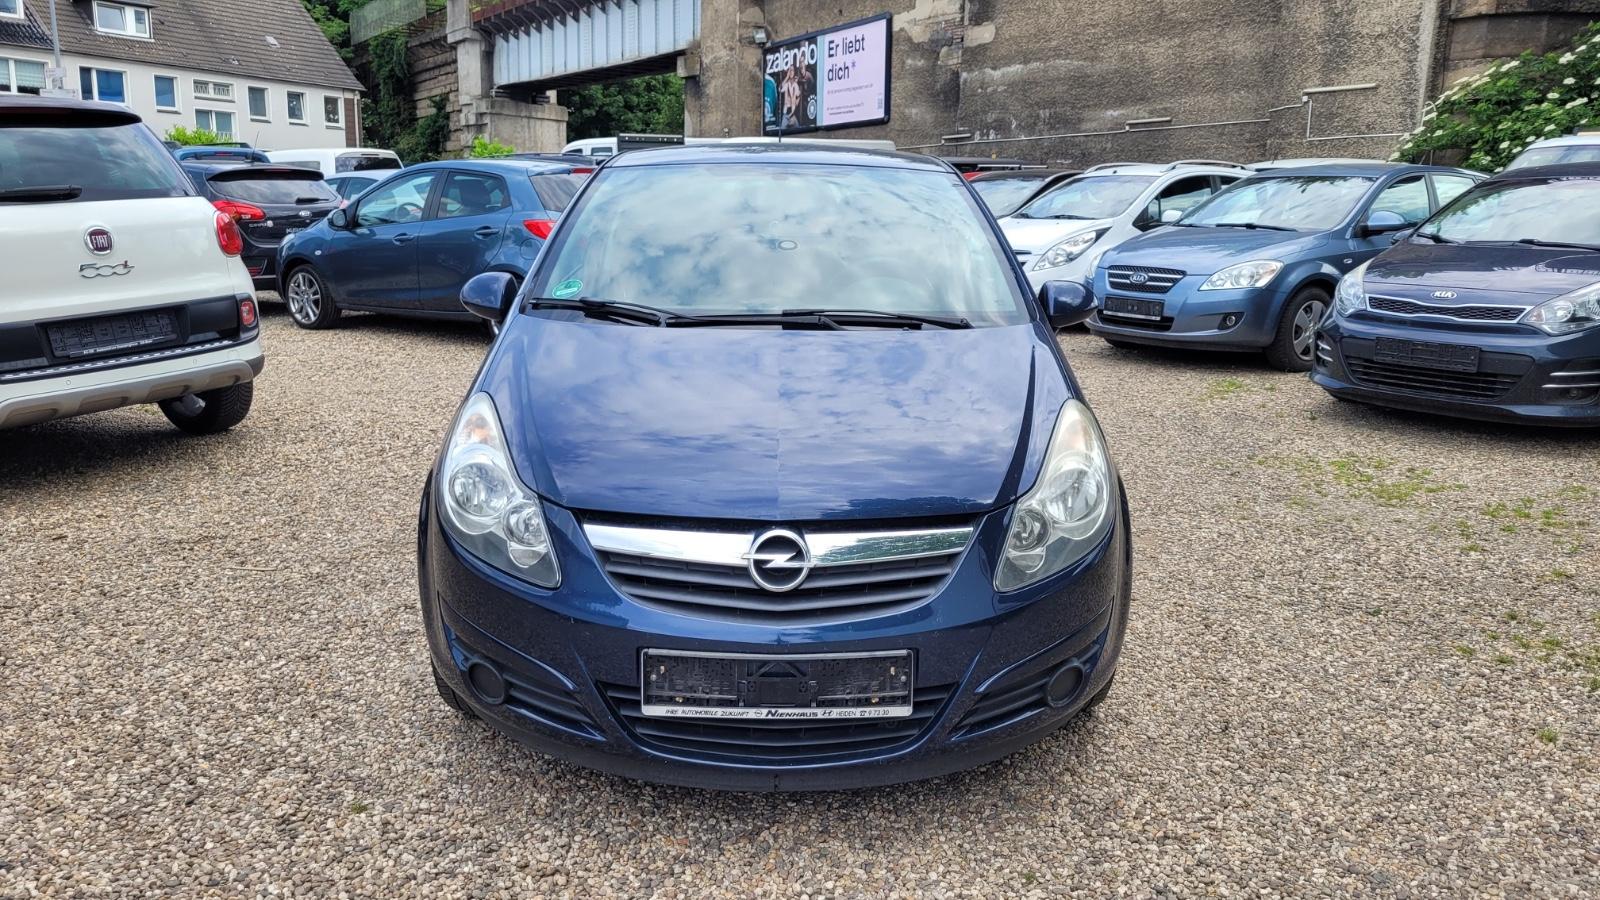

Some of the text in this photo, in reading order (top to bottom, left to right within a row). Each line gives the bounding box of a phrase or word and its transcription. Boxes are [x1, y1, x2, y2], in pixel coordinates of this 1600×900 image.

[828, 34, 865, 58] Er liebt
[766, 42, 818, 74] zalando
[91, 234, 109, 249] FIAT
[1132, 274, 1145, 283] KIA
[1434, 290, 1453, 298] KIA
